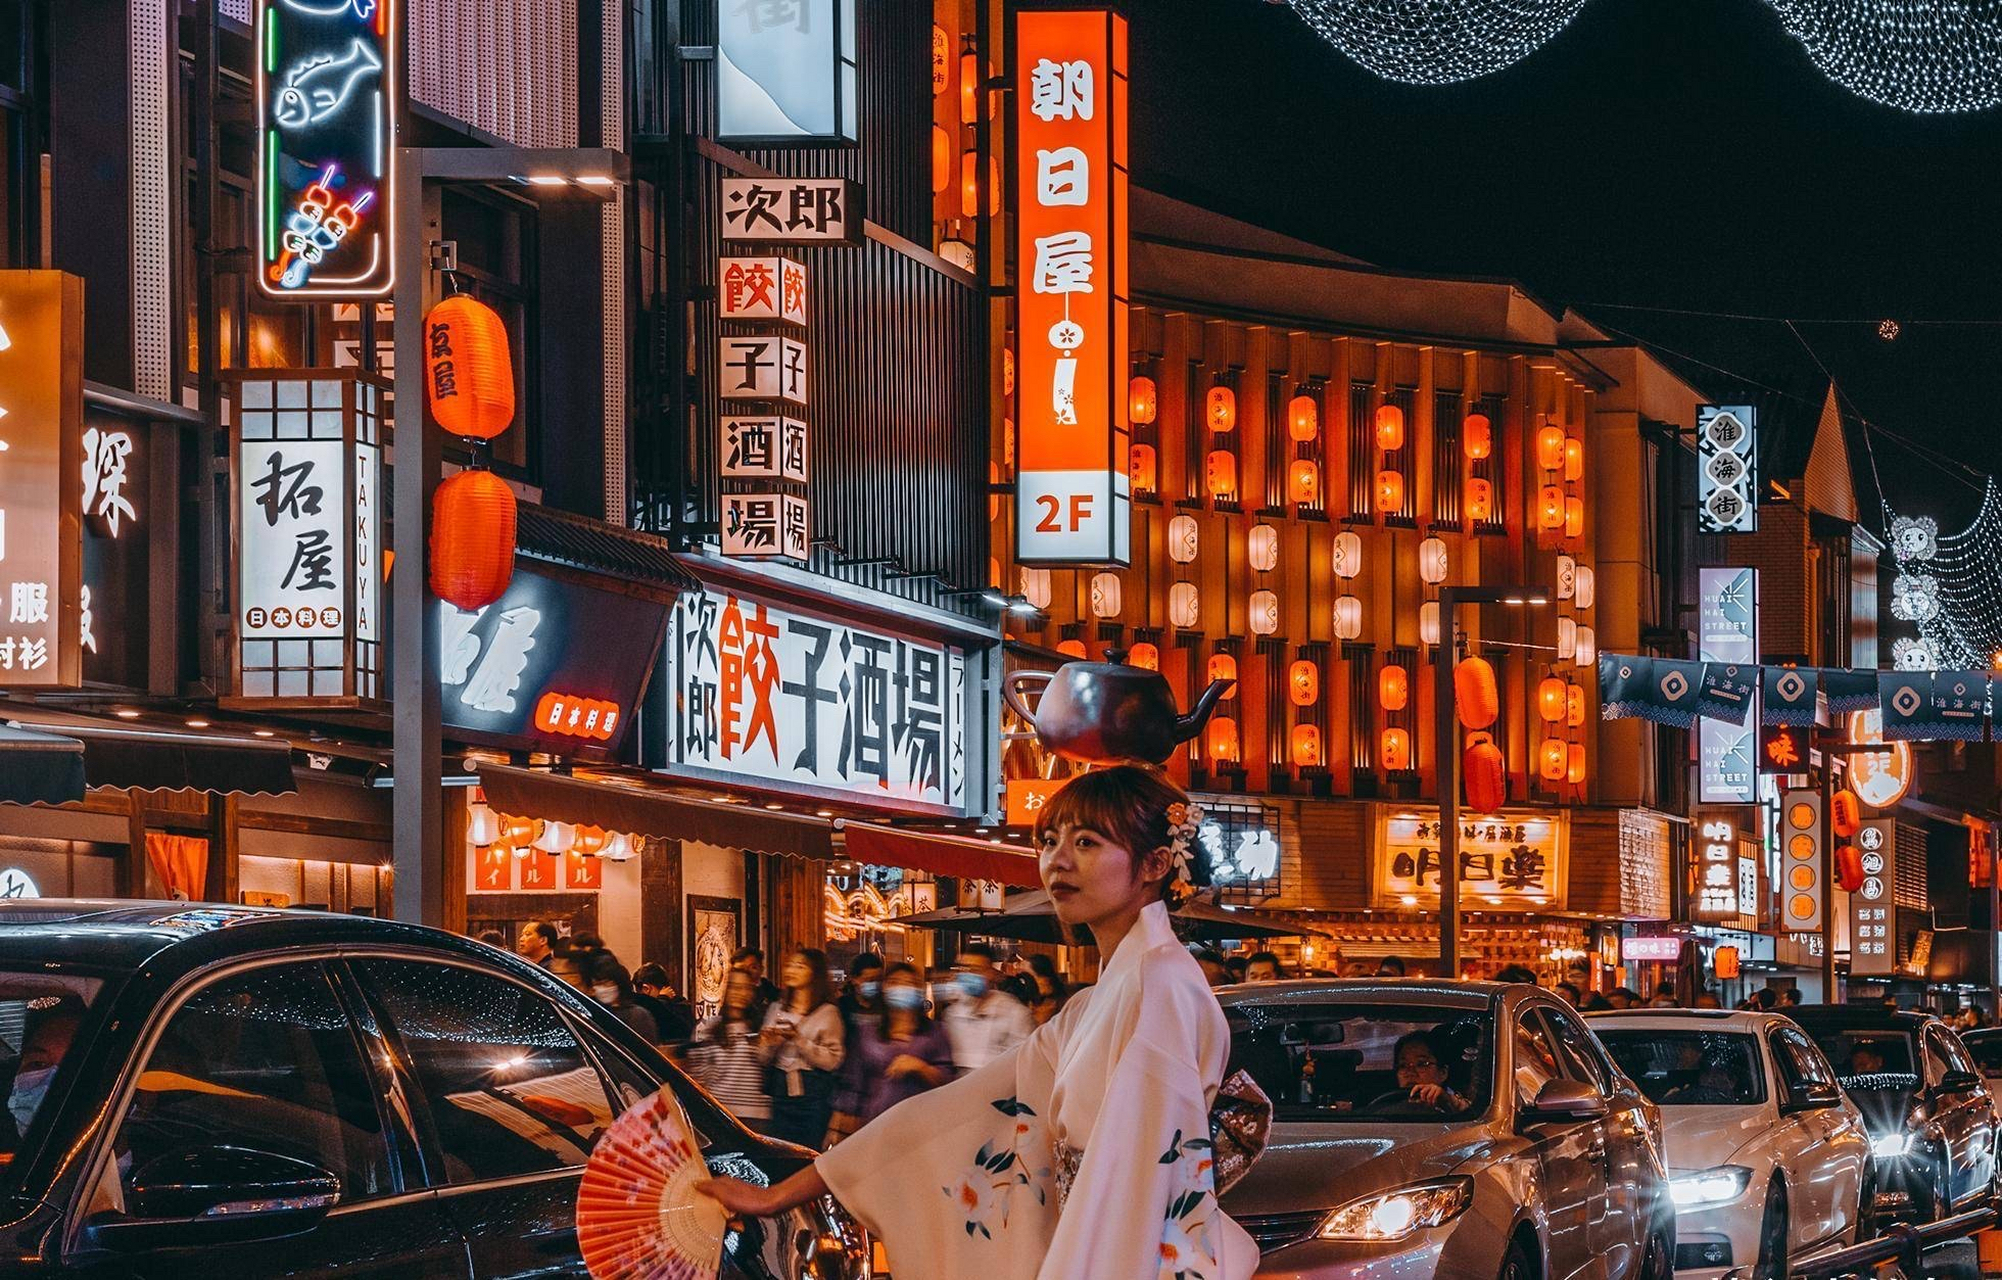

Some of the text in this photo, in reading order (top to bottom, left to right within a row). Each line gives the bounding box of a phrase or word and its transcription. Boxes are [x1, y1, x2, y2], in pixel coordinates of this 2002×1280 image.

[1030, 59, 1095, 294] 朝日屋
[725, 184, 842, 234] 次郎
[724, 262, 775, 548] 餃子酒場
[783, 264, 806, 552] 餃子酒場
[1714, 421, 1738, 515] 淮海街
[250, 450, 337, 592] 拓屋
[1035, 494, 1094, 533] 2F
[357, 456, 369, 631] TAKUYA
[248, 607, 341, 628] 日本料理
[1704, 595, 1732, 603] HUAI
[1704, 608, 1725, 617] HAI
[1704, 622, 1747, 630] STREET
[686, 590, 718, 763] 次郎
[718, 591, 943, 798] 餃子酒場
[952, 656, 965, 797] ラーメン
[1936, 697, 1982, 711] 淮海街
[1705, 746, 1733, 754] HUAI
[1705, 760, 1726, 768] HAI
[1705, 773, 1748, 782] STREET
